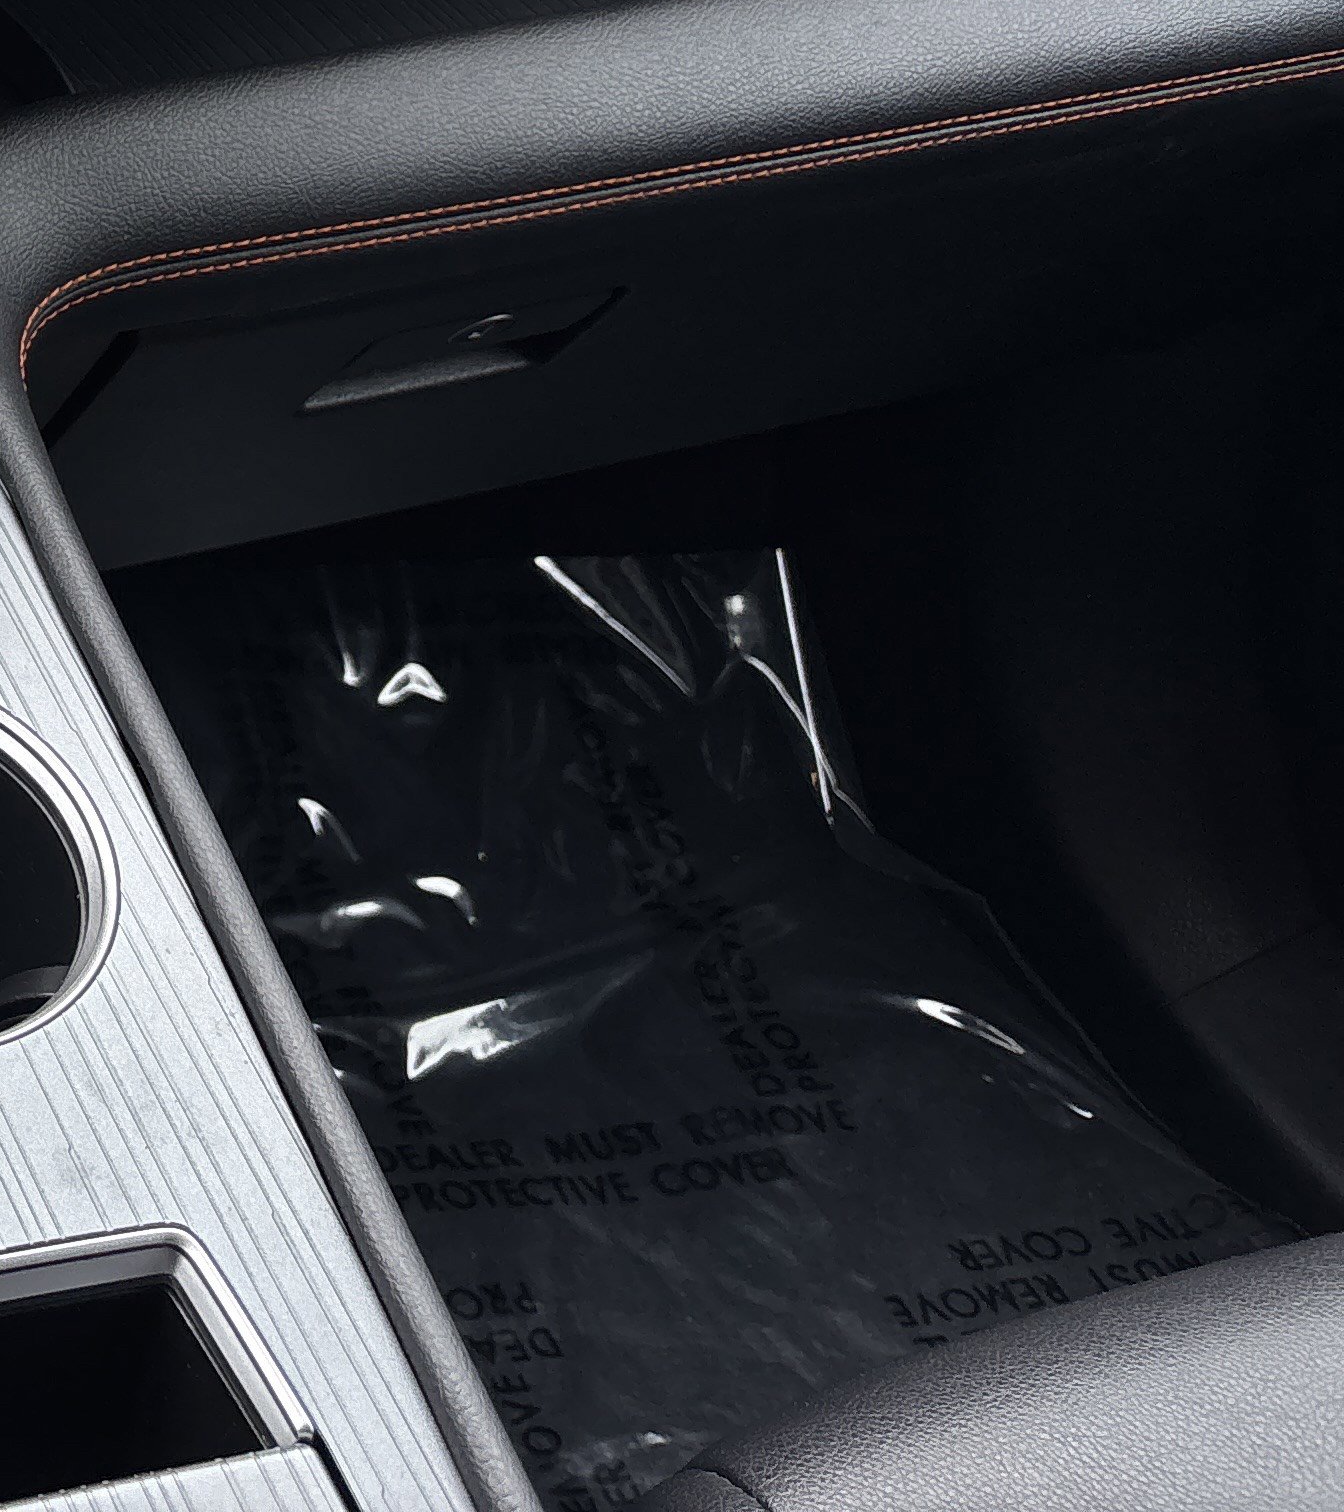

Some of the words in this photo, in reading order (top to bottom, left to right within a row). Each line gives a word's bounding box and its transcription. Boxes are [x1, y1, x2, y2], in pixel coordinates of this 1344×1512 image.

[543, 1121, 663, 1166] MUST
[689, 1097, 859, 1148] REMOVE
[650, 1148, 801, 1191] COVER
